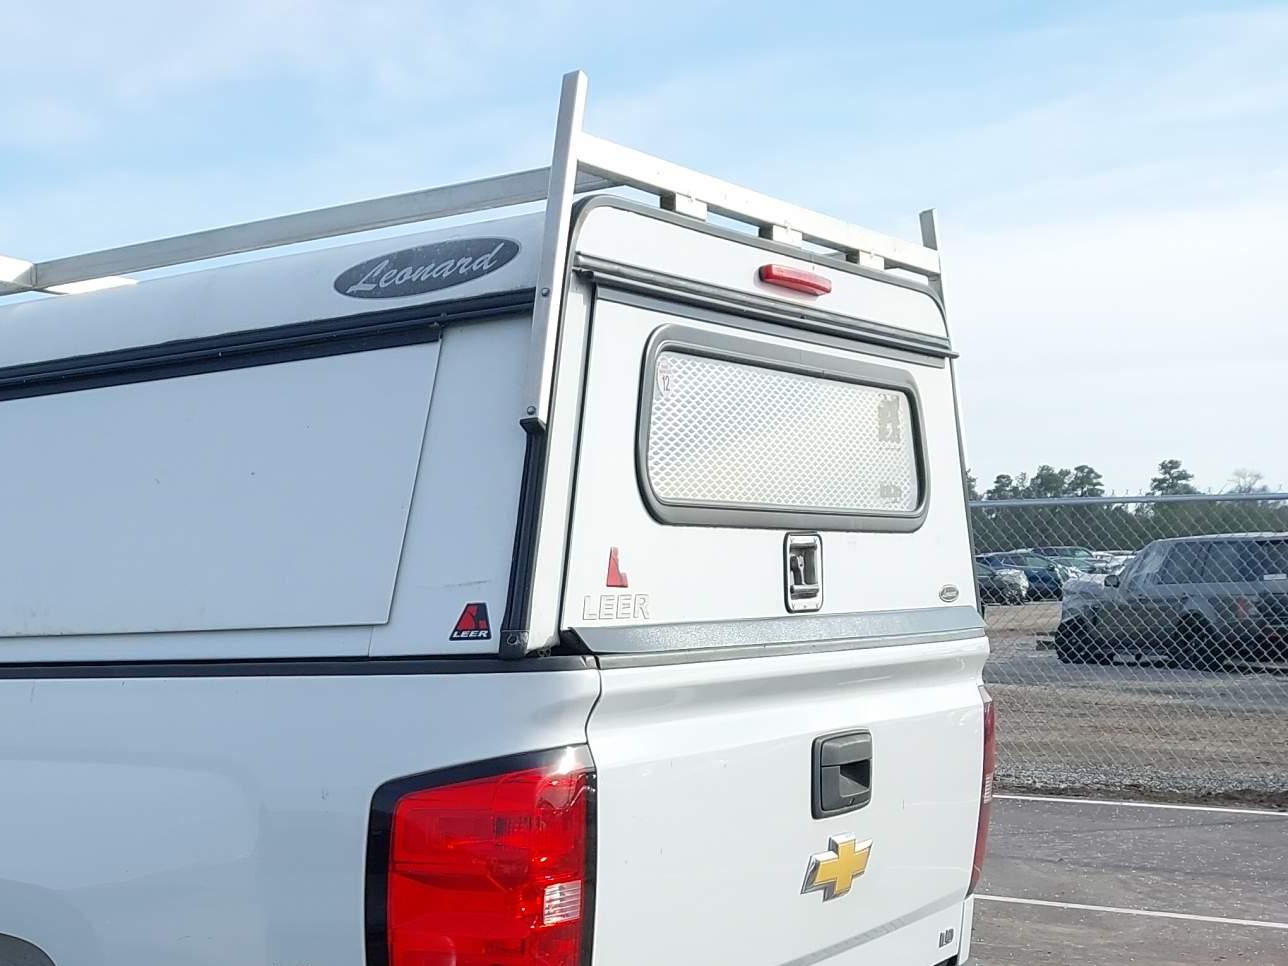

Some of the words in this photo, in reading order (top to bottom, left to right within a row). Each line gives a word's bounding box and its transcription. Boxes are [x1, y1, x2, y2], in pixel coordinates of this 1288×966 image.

[346, 242, 505, 294] Leonard
[581, 593, 650, 621] LEER
[452, 629, 490, 639] LEER
